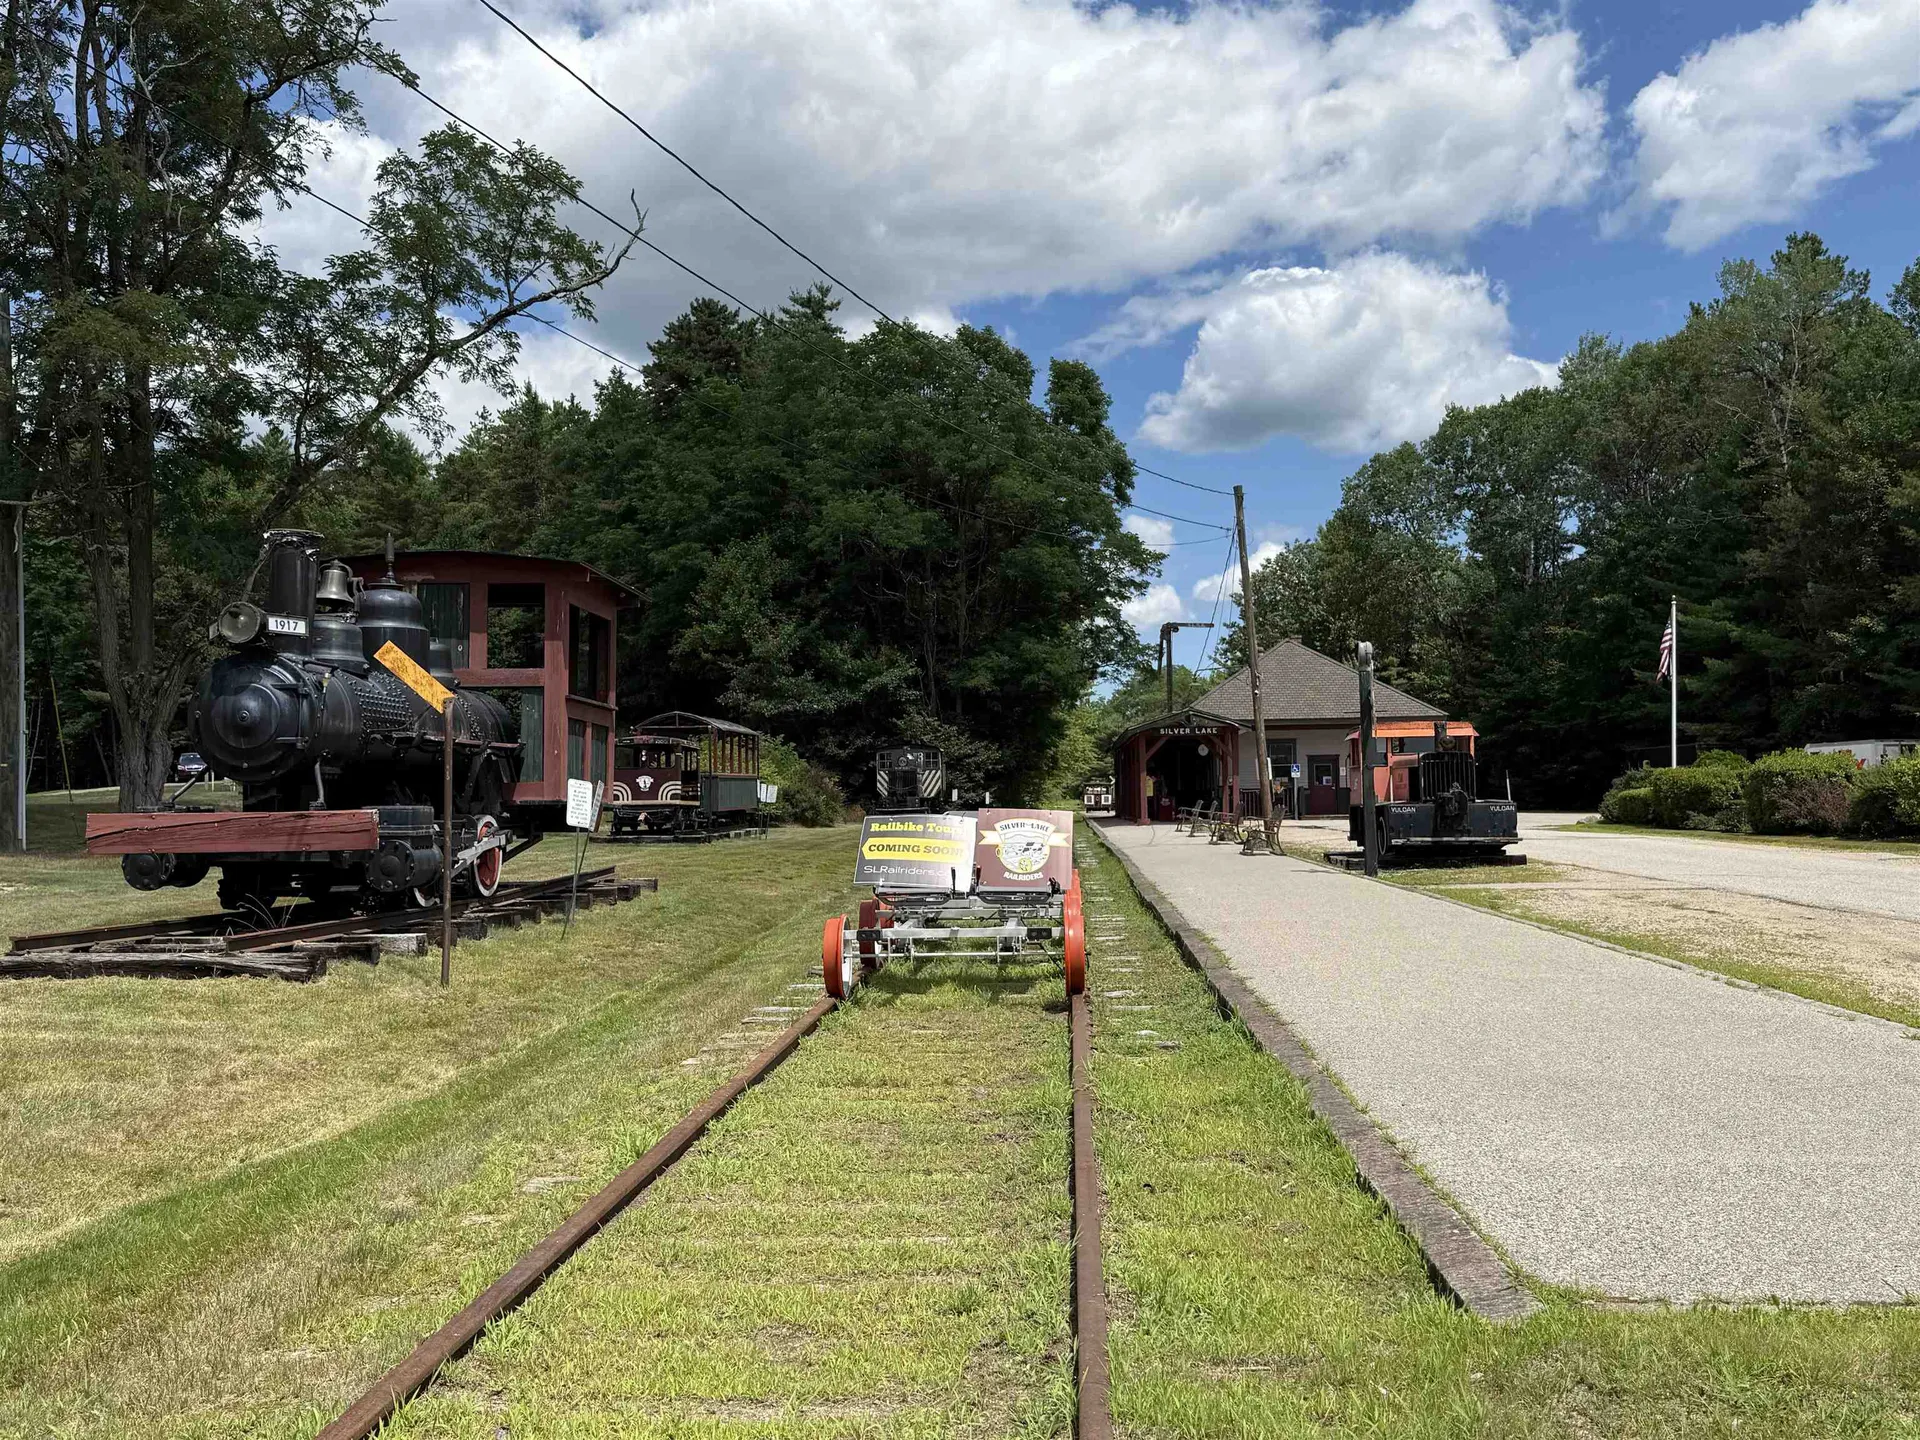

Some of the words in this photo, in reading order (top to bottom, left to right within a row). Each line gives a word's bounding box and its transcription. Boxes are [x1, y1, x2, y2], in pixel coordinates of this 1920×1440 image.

[275, 619, 299, 631] 1917
[870, 822, 924, 832] Railbike
[1000, 822, 1025, 831] SILVER
[1031, 822, 1050, 832] LAKE
[868, 843, 921, 854] COMING
[923, 845, 964, 858] SOON!
[863, 865, 951, 876] SLRailriders.c
[1003, 871, 1044, 881] RAILRIDERS
